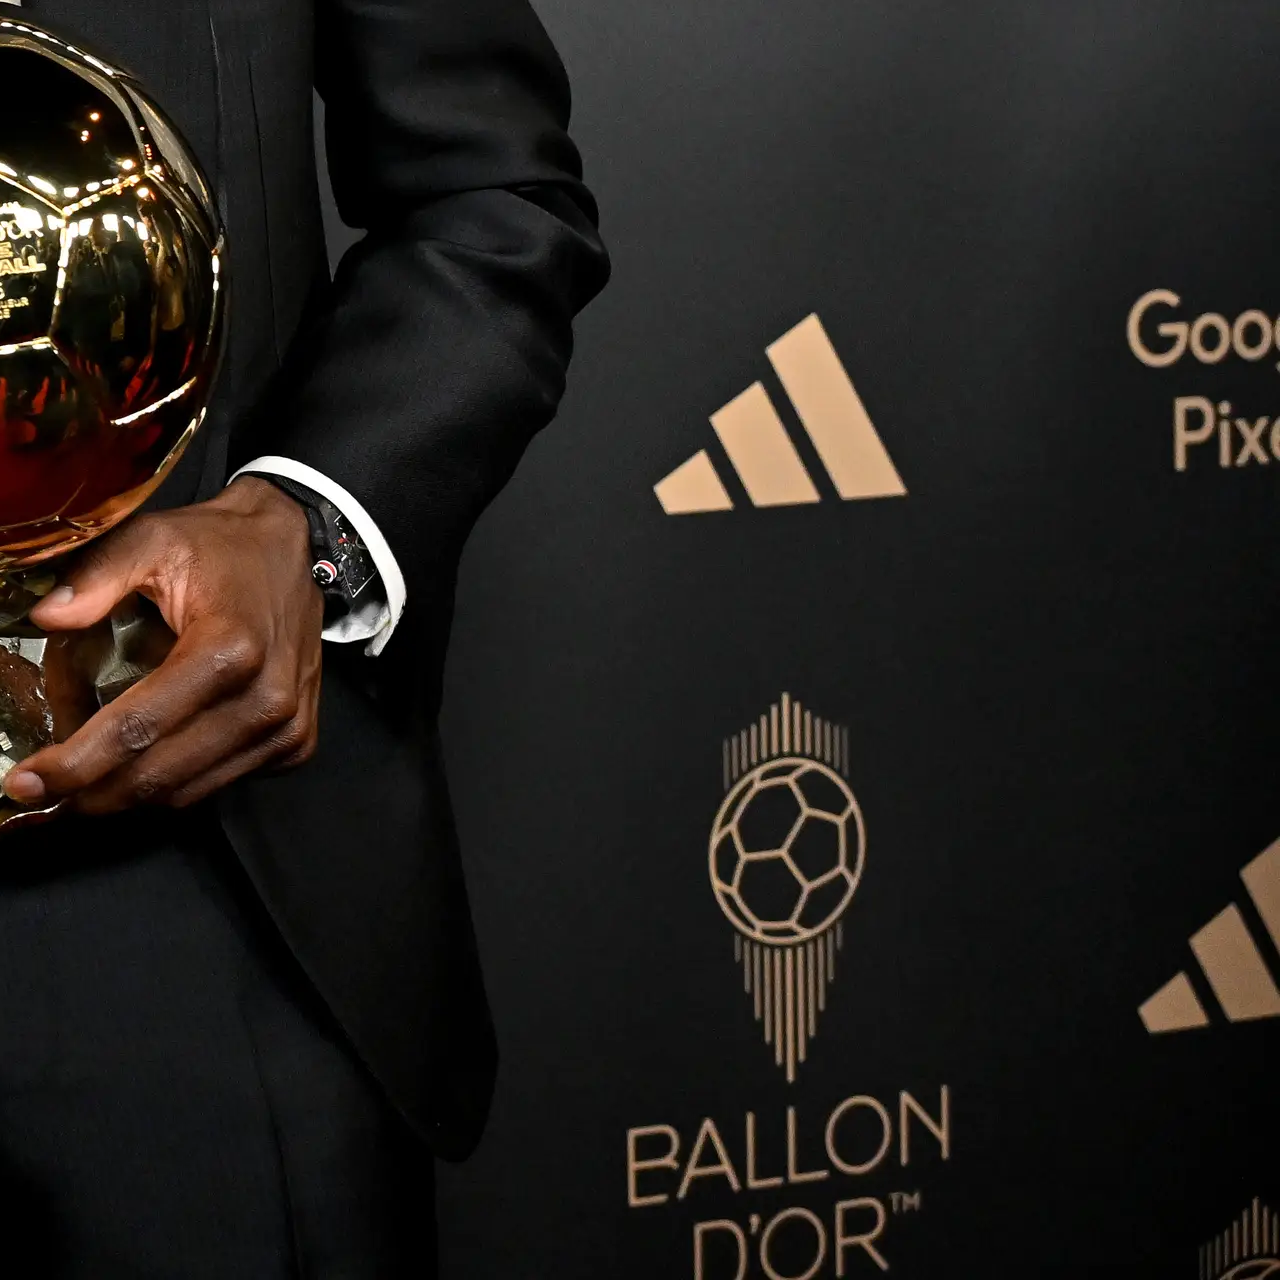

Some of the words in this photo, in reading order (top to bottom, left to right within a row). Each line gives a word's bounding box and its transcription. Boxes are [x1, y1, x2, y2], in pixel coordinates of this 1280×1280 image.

[1127, 288, 1280, 368] Goo
[1174, 395, 1280, 472] Pix
[627, 1083, 950, 1207] BALLON
